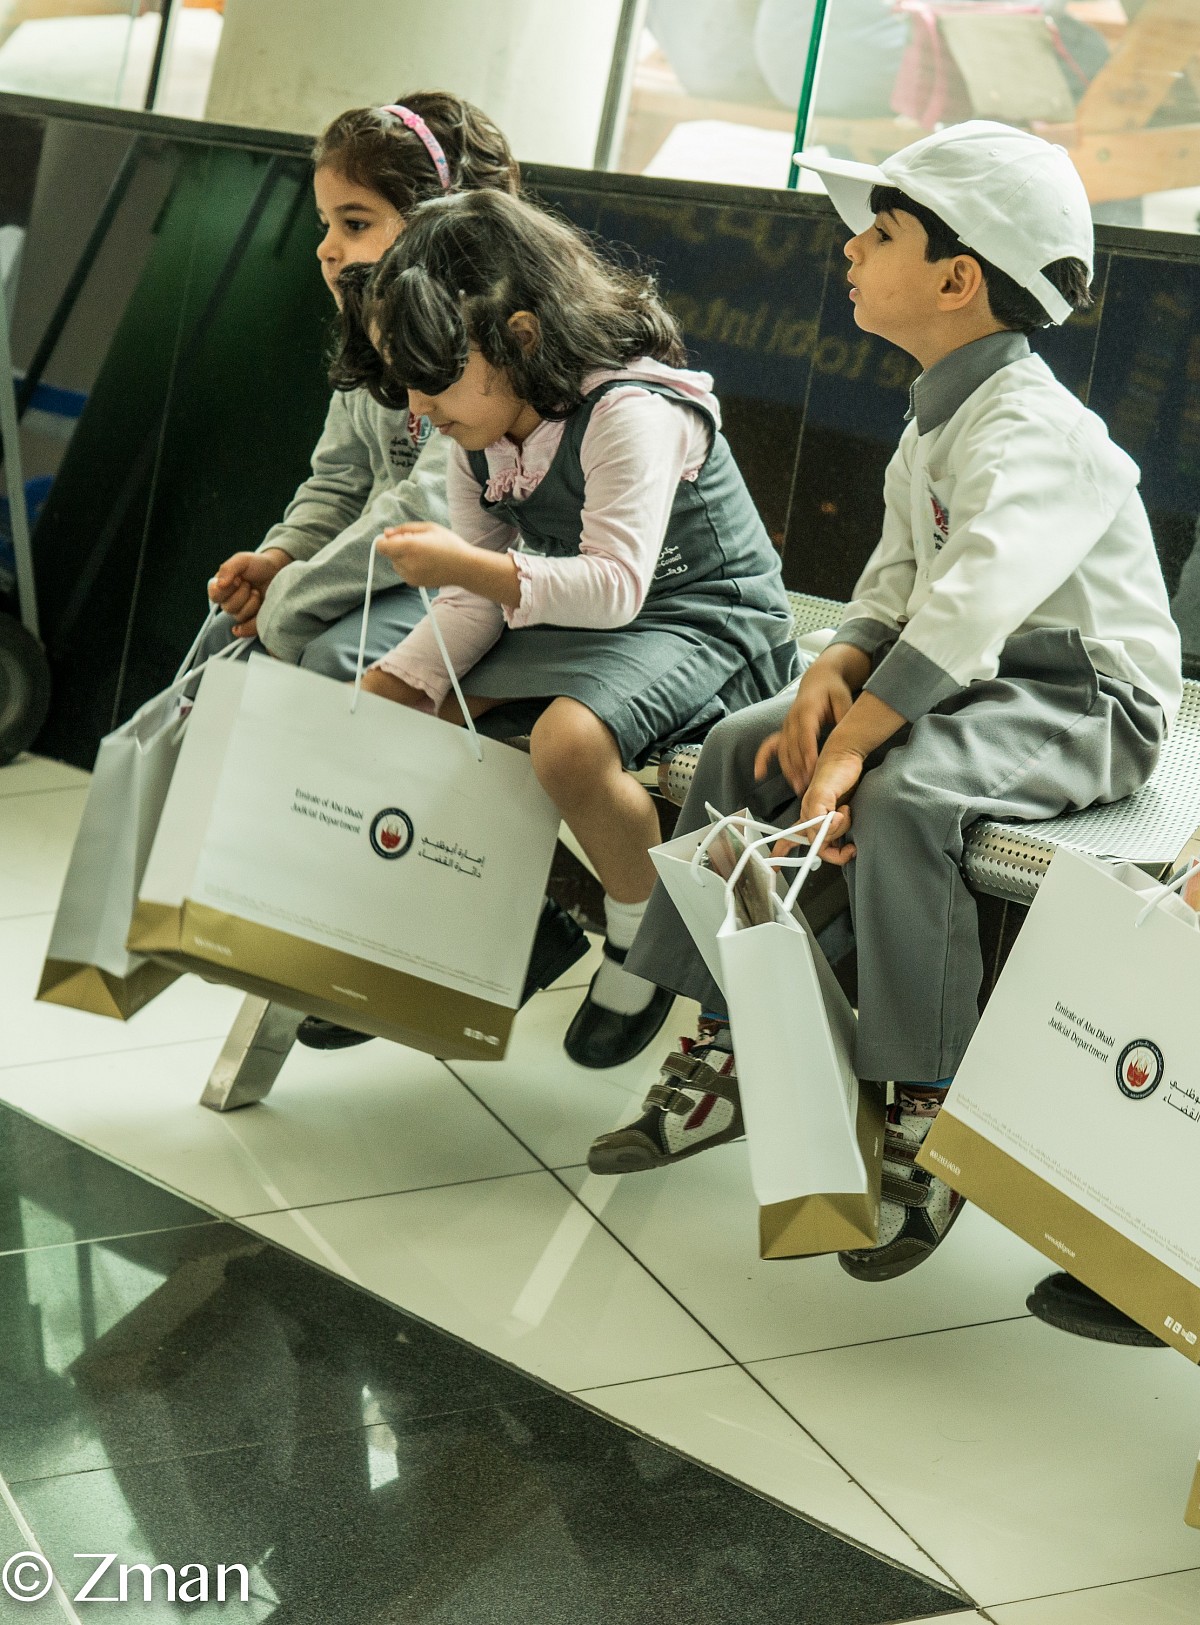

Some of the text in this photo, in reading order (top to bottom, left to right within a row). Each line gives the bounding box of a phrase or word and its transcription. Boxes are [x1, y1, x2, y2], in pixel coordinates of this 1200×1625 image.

[319, 812, 360, 834] Department
[344, 806, 364, 820] Dhabi
[1048, 1017, 1108, 1063] Judicial Department
[1055, 1001, 1116, 1048] Emirate of Abu Dhabi
